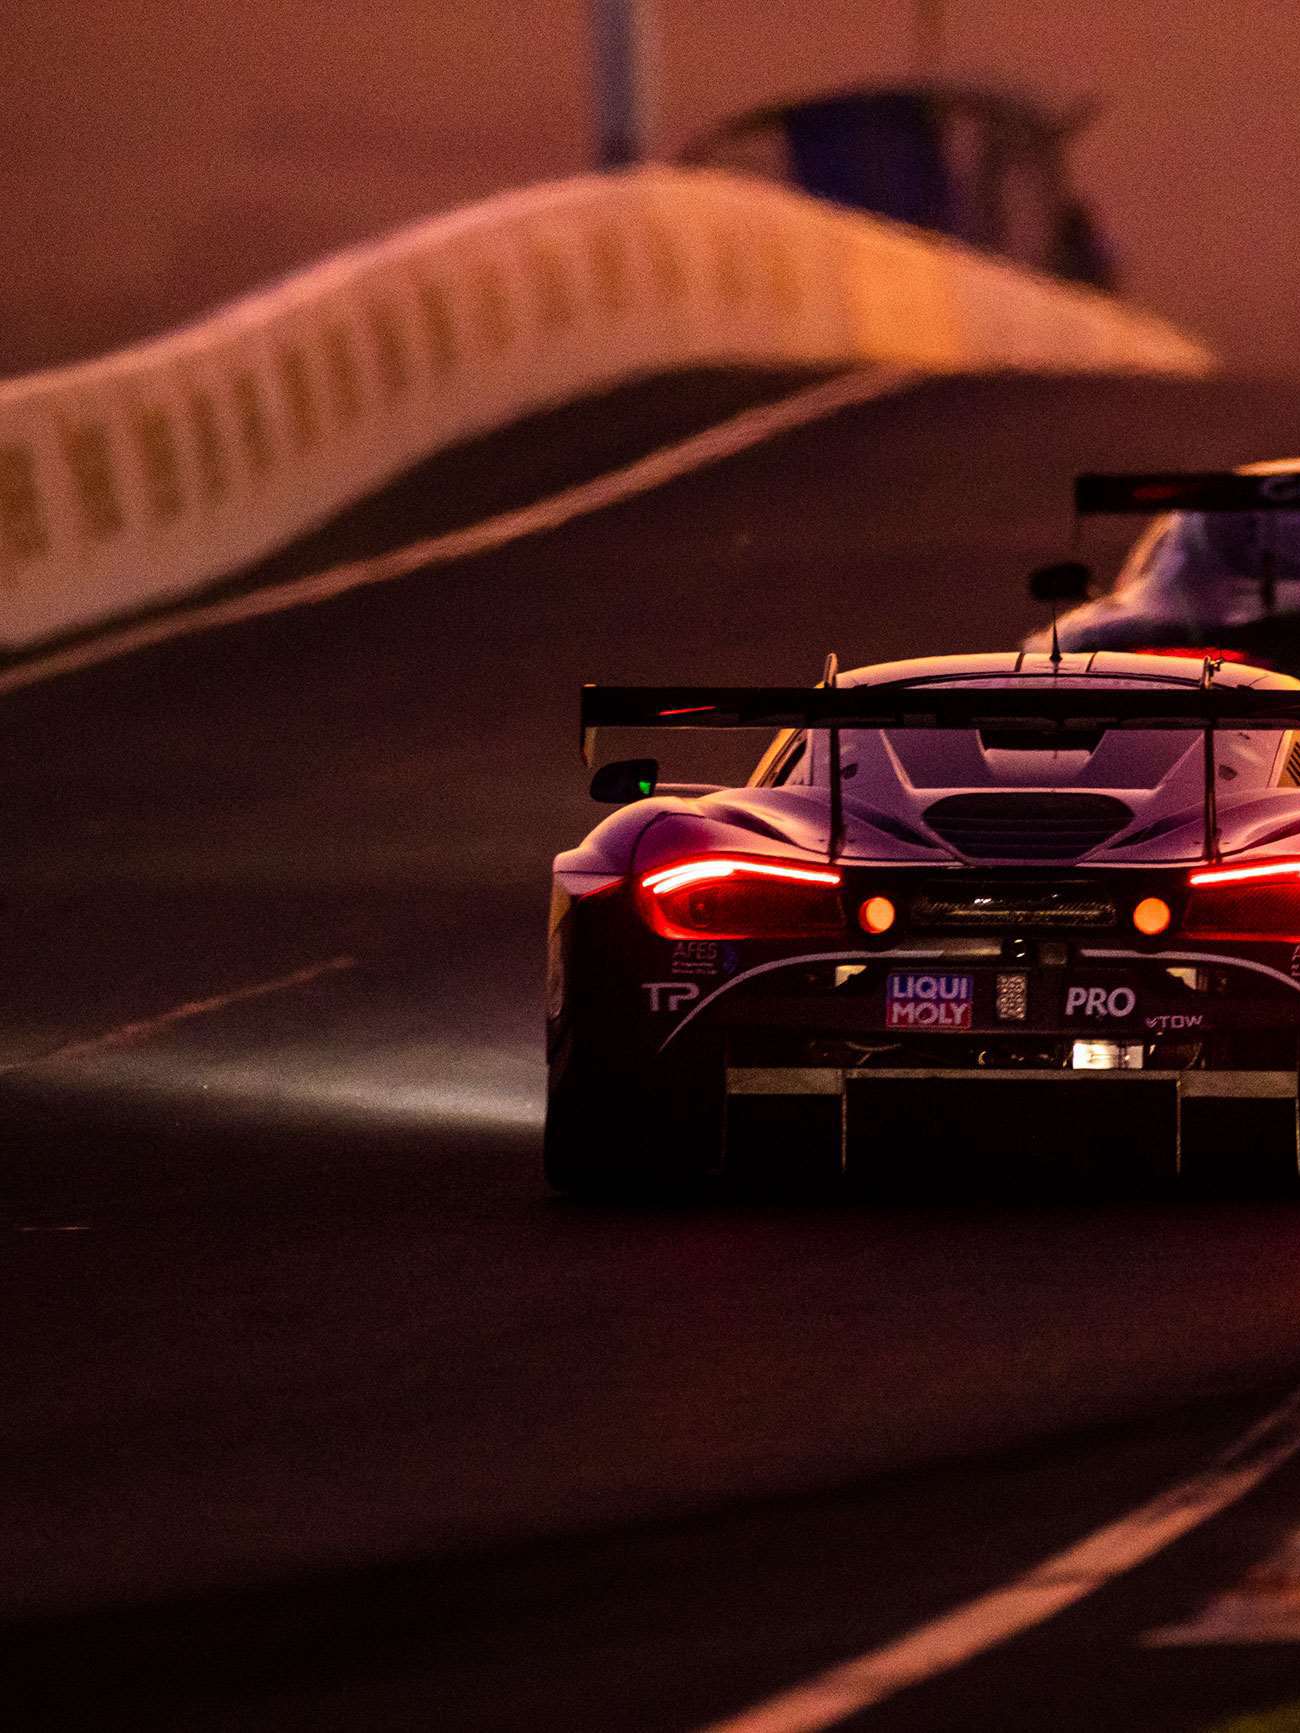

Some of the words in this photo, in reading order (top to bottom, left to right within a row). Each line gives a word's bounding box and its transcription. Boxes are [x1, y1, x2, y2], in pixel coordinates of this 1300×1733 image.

[672, 941, 718, 960] AFES
[641, 982, 700, 1013] TP
[893, 976, 968, 999] LIQUI
[892, 1001, 968, 1024] MOLY
[1065, 986, 1137, 1017] PRO
